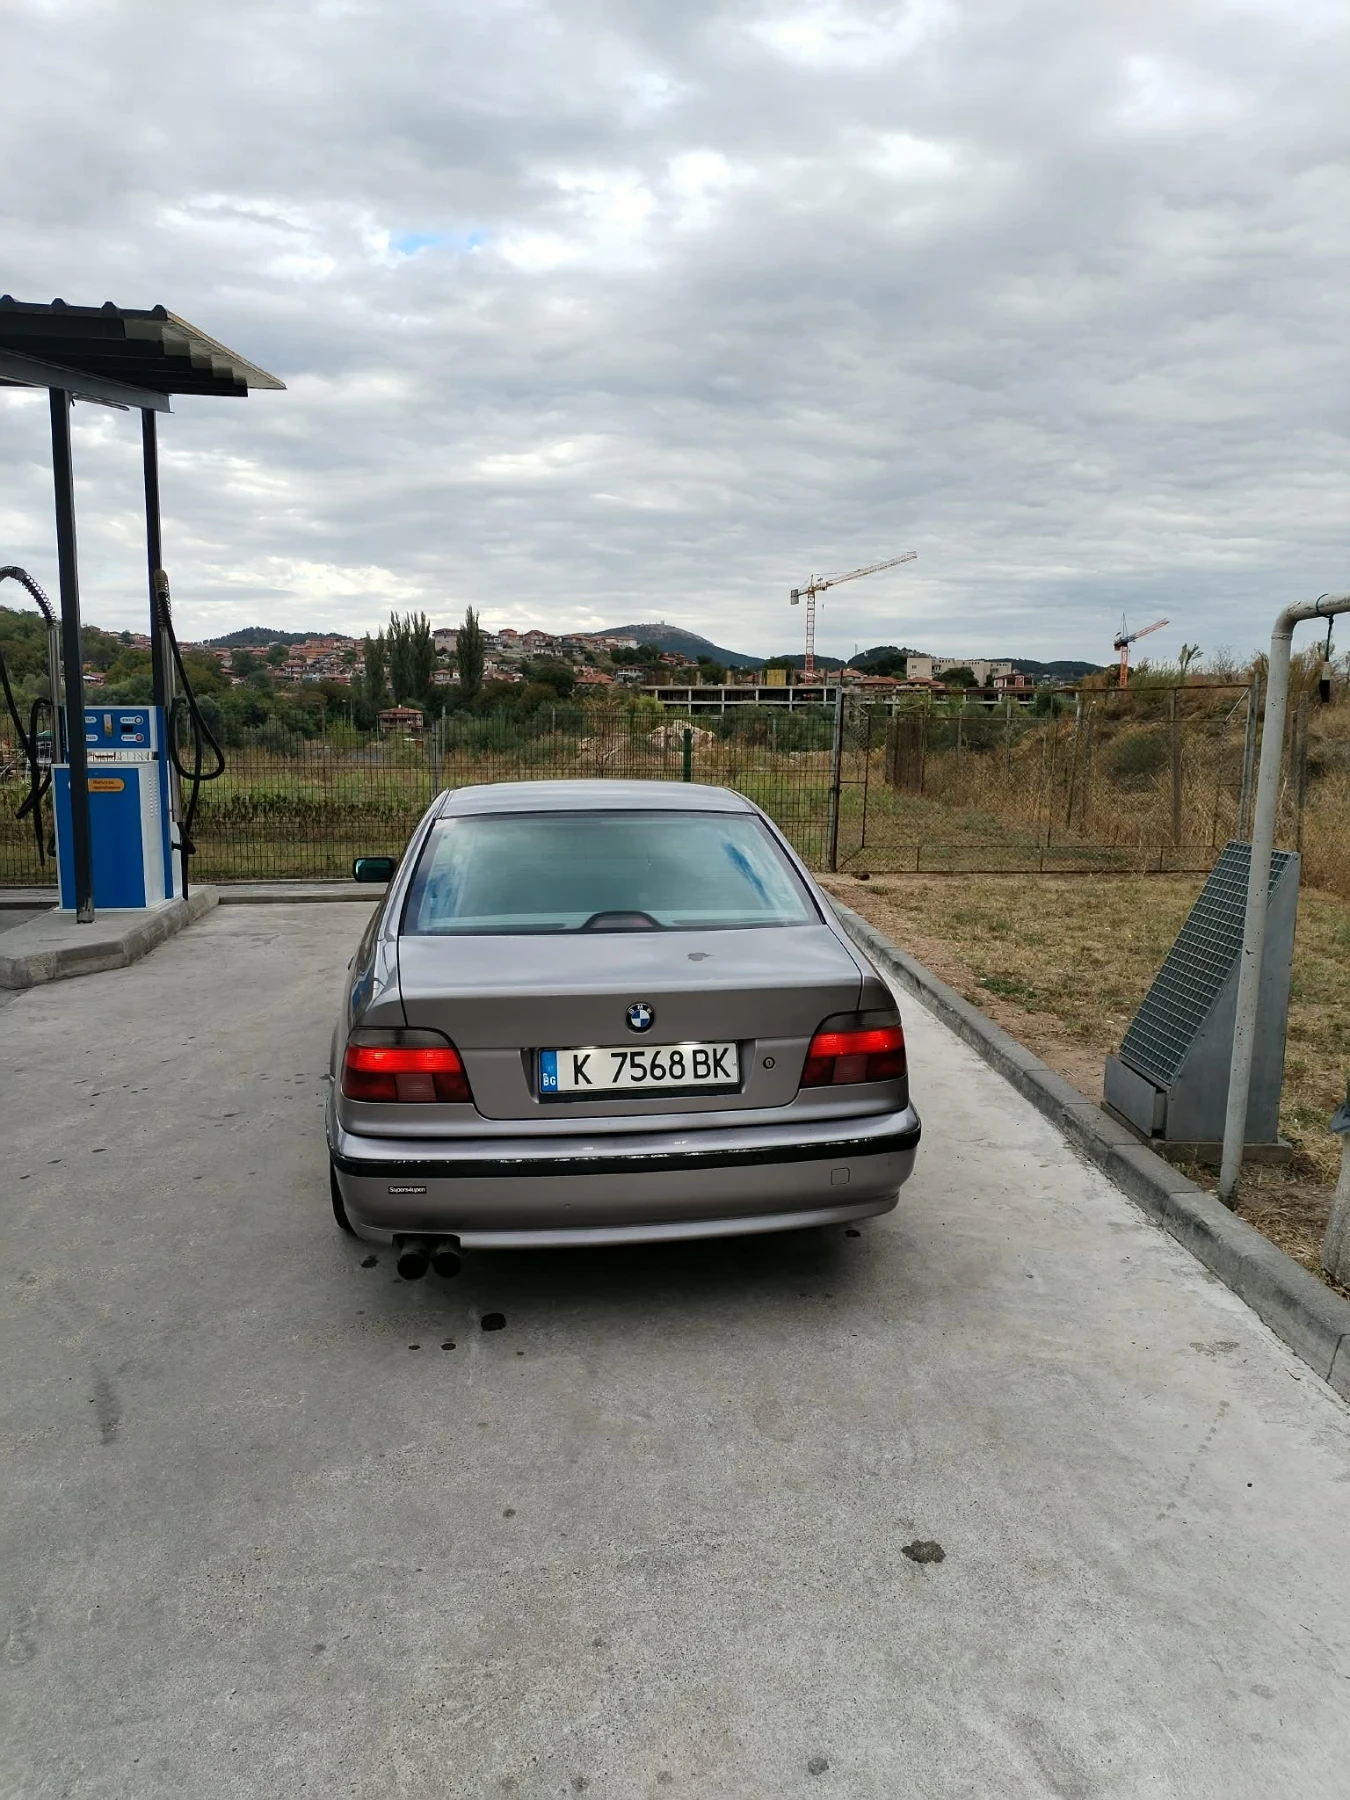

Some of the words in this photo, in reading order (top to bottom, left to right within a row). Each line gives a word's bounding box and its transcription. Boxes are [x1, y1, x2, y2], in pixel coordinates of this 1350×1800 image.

[573, 1054, 593, 1086] K
[610, 1050, 686, 1083] 7568
[692, 1047, 732, 1080] BK
[543, 1076, 556, 1086] BG
